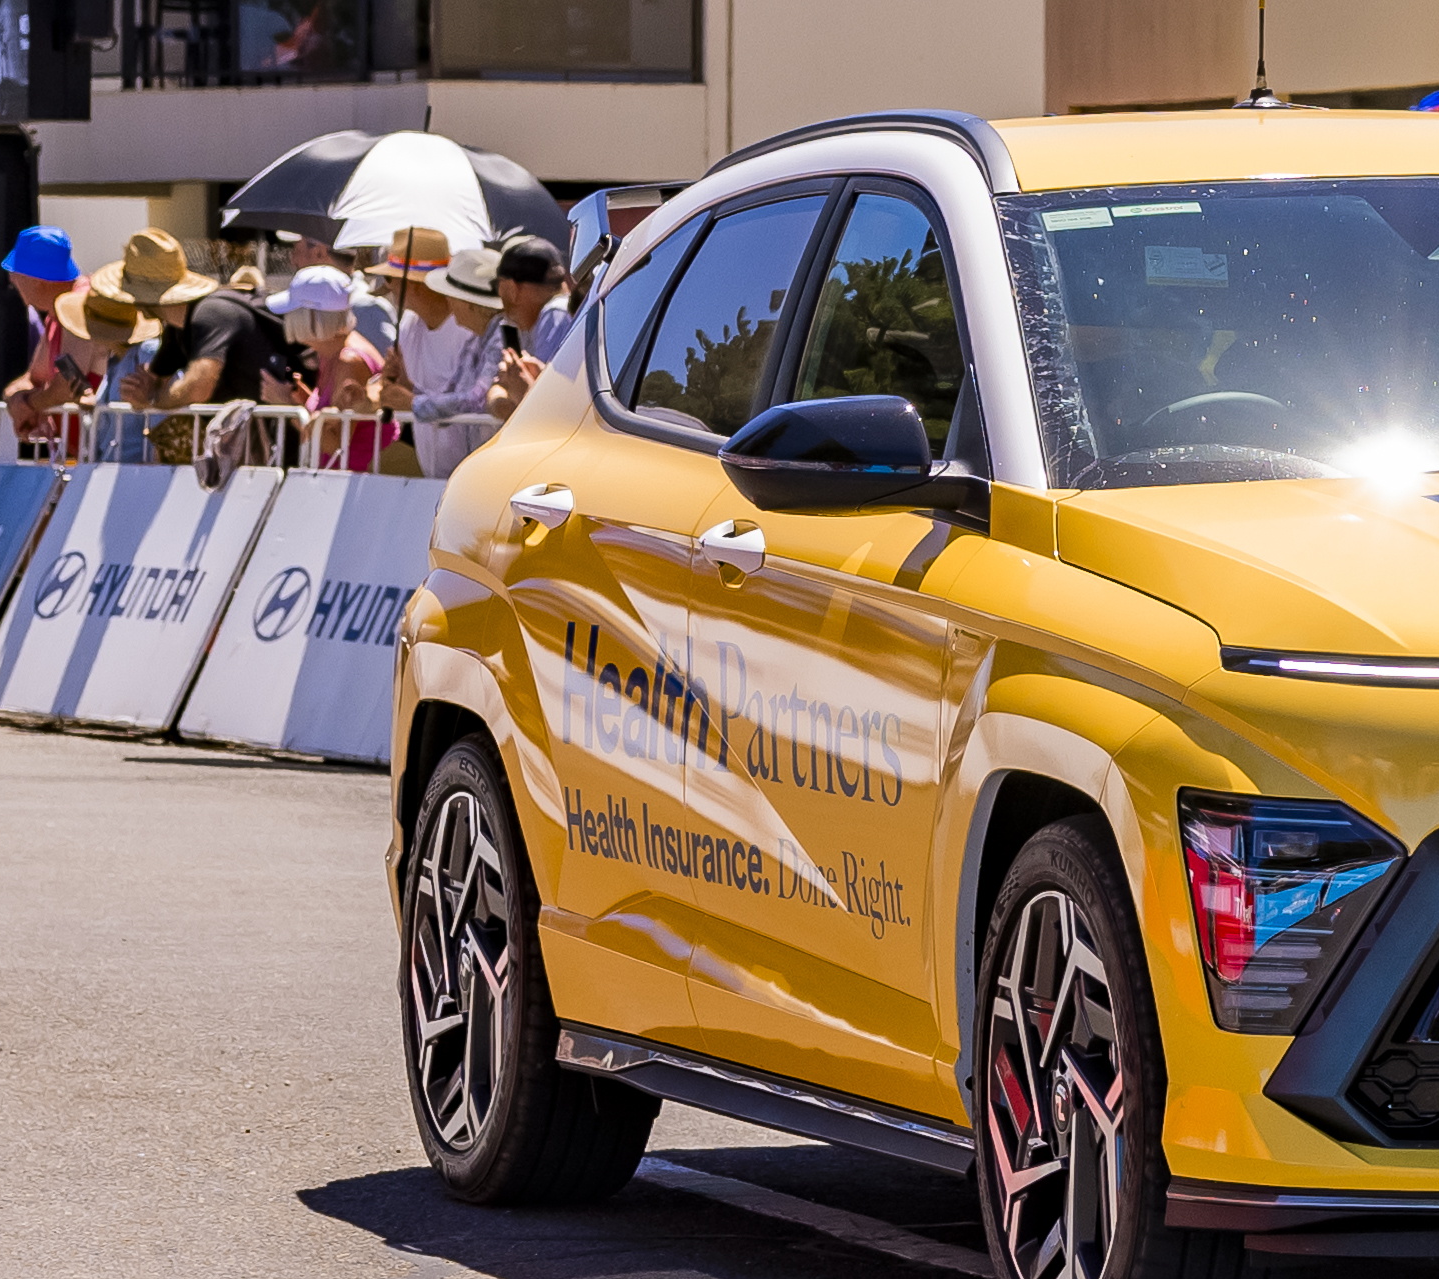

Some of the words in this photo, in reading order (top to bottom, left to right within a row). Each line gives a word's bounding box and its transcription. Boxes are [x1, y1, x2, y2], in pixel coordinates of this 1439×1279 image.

[83, 562, 207, 624] HYUNDAI
[562, 621, 710, 768] Health
[714, 640, 904, 807] Partners
[563, 786, 641, 865] Health
[642, 802, 771, 896] Insurance.
[776, 837, 840, 910] Done
[841, 850, 912, 941] Right.
